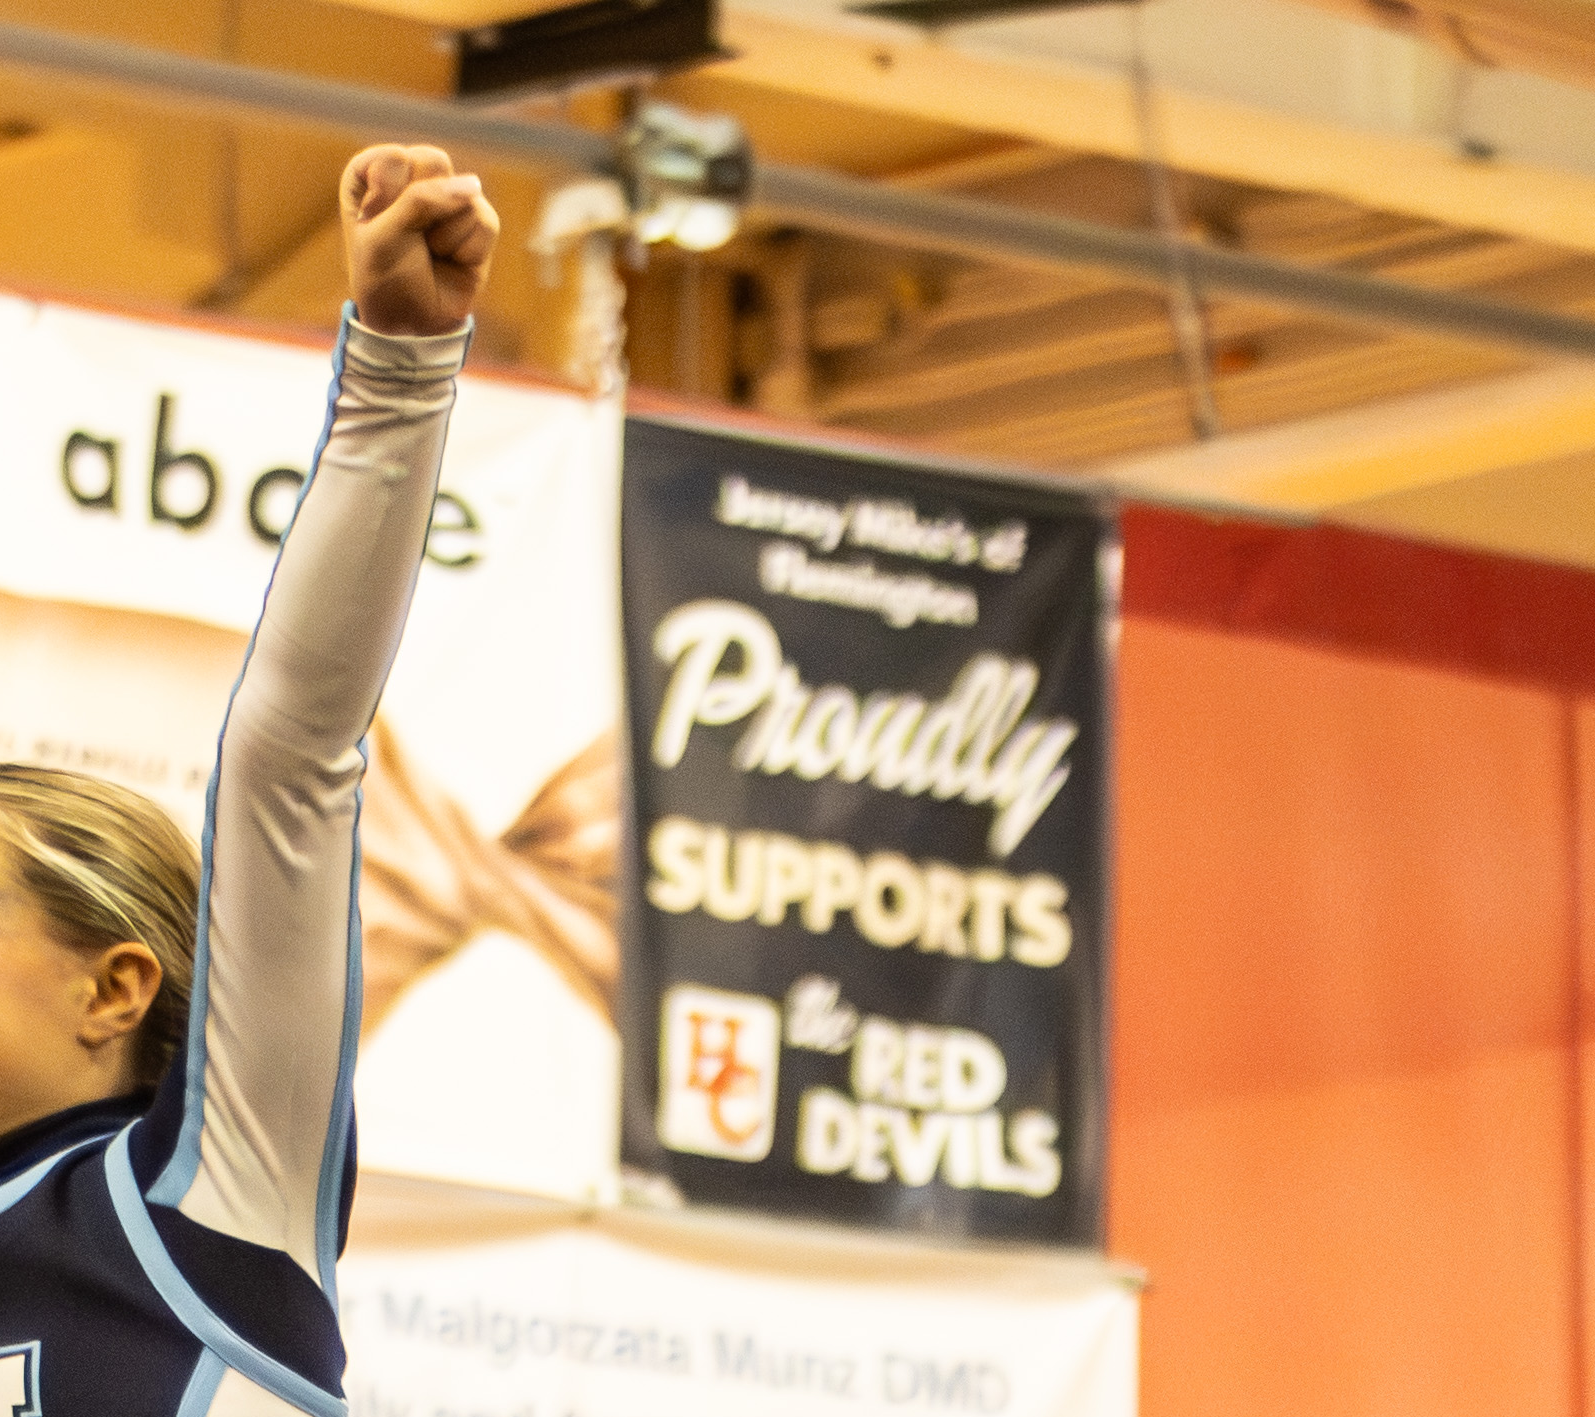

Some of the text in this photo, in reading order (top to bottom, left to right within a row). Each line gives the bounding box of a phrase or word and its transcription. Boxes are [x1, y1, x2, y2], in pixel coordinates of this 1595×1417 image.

[59, 392, 486, 571] aboe
[652, 598, 1079, 860] Proudly
[646, 815, 1074, 968] SUPPORTS
[851, 1022, 1009, 1114] RED
[796, 1088, 1063, 1199] DEVILS
[880, 1350, 1013, 1417] DMD
